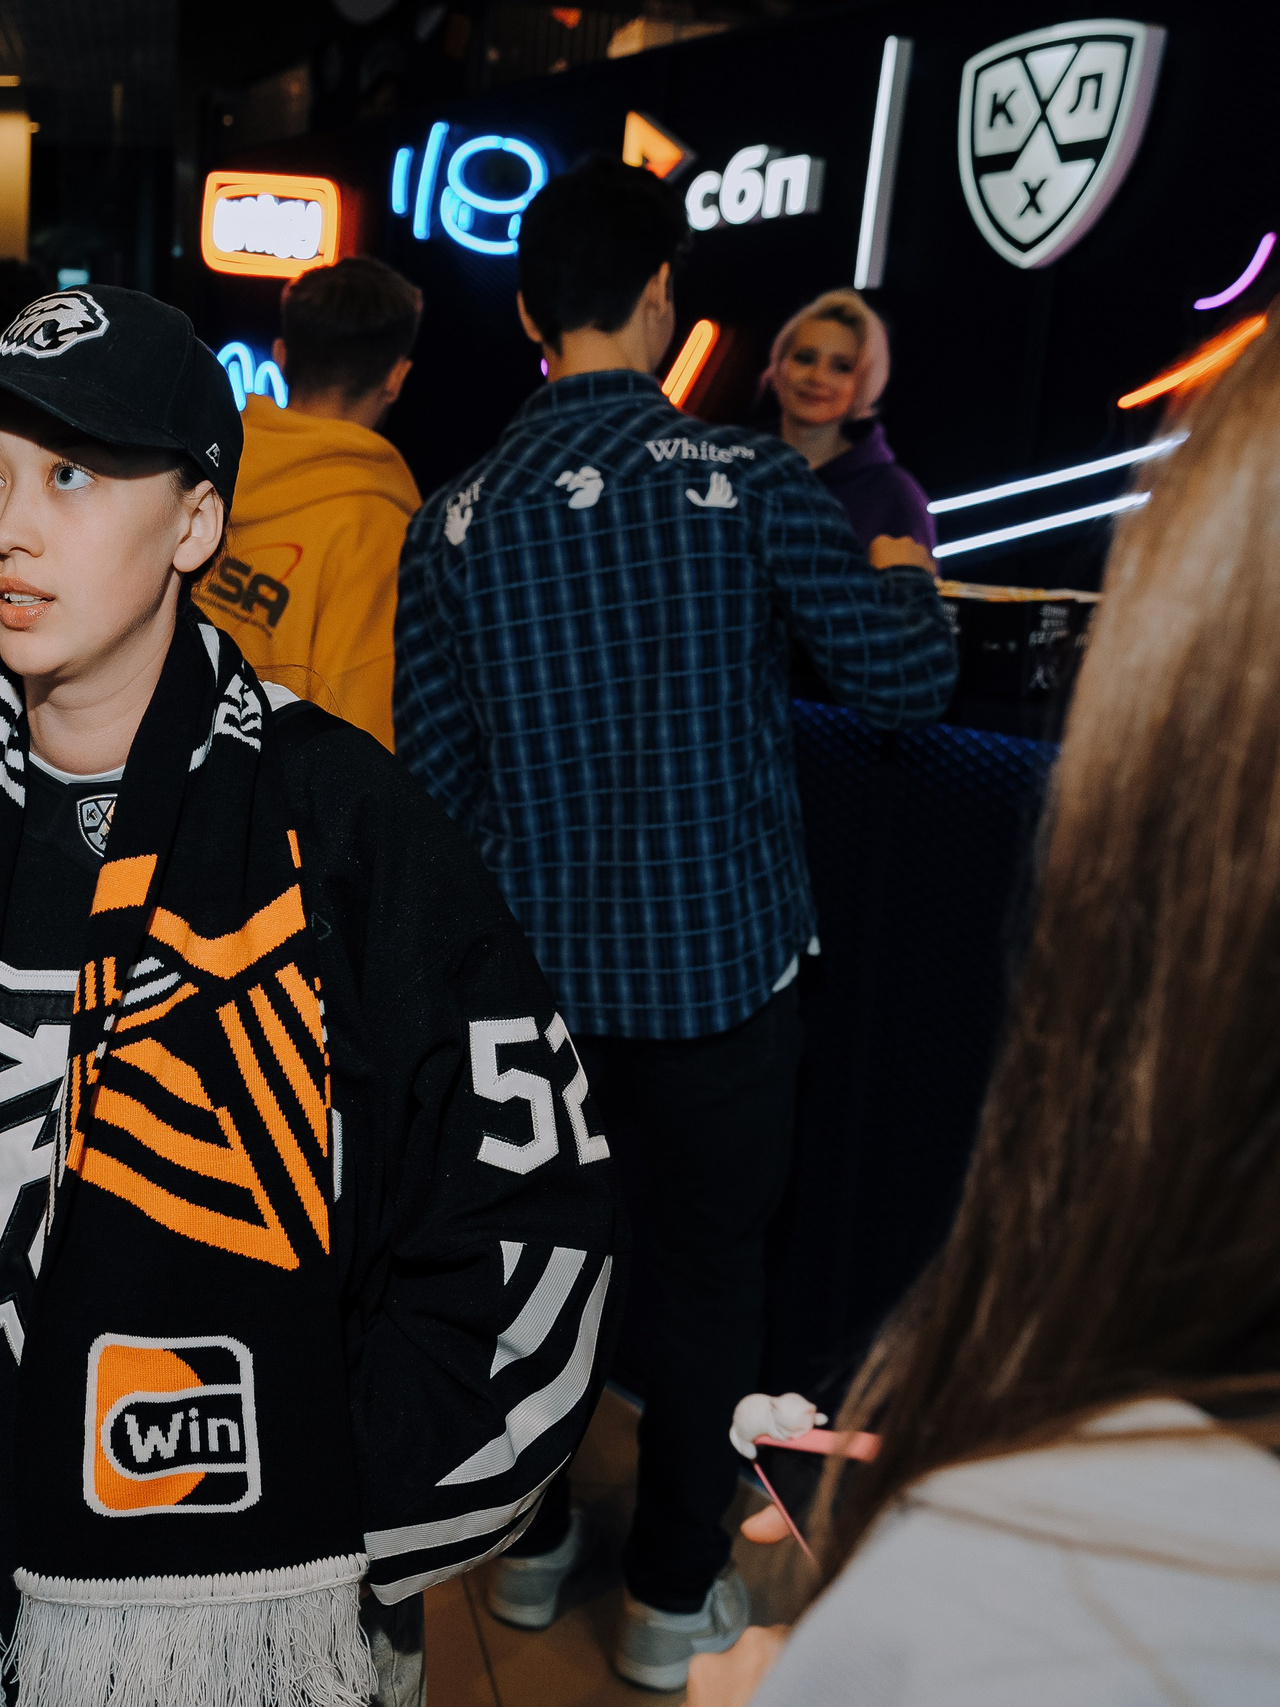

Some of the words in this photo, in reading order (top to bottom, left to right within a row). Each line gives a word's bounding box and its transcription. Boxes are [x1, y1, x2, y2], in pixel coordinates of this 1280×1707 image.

[684, 143, 812, 232] сбп
[468, 1011, 612, 1175] 52
[124, 1406, 241, 1464] Win
